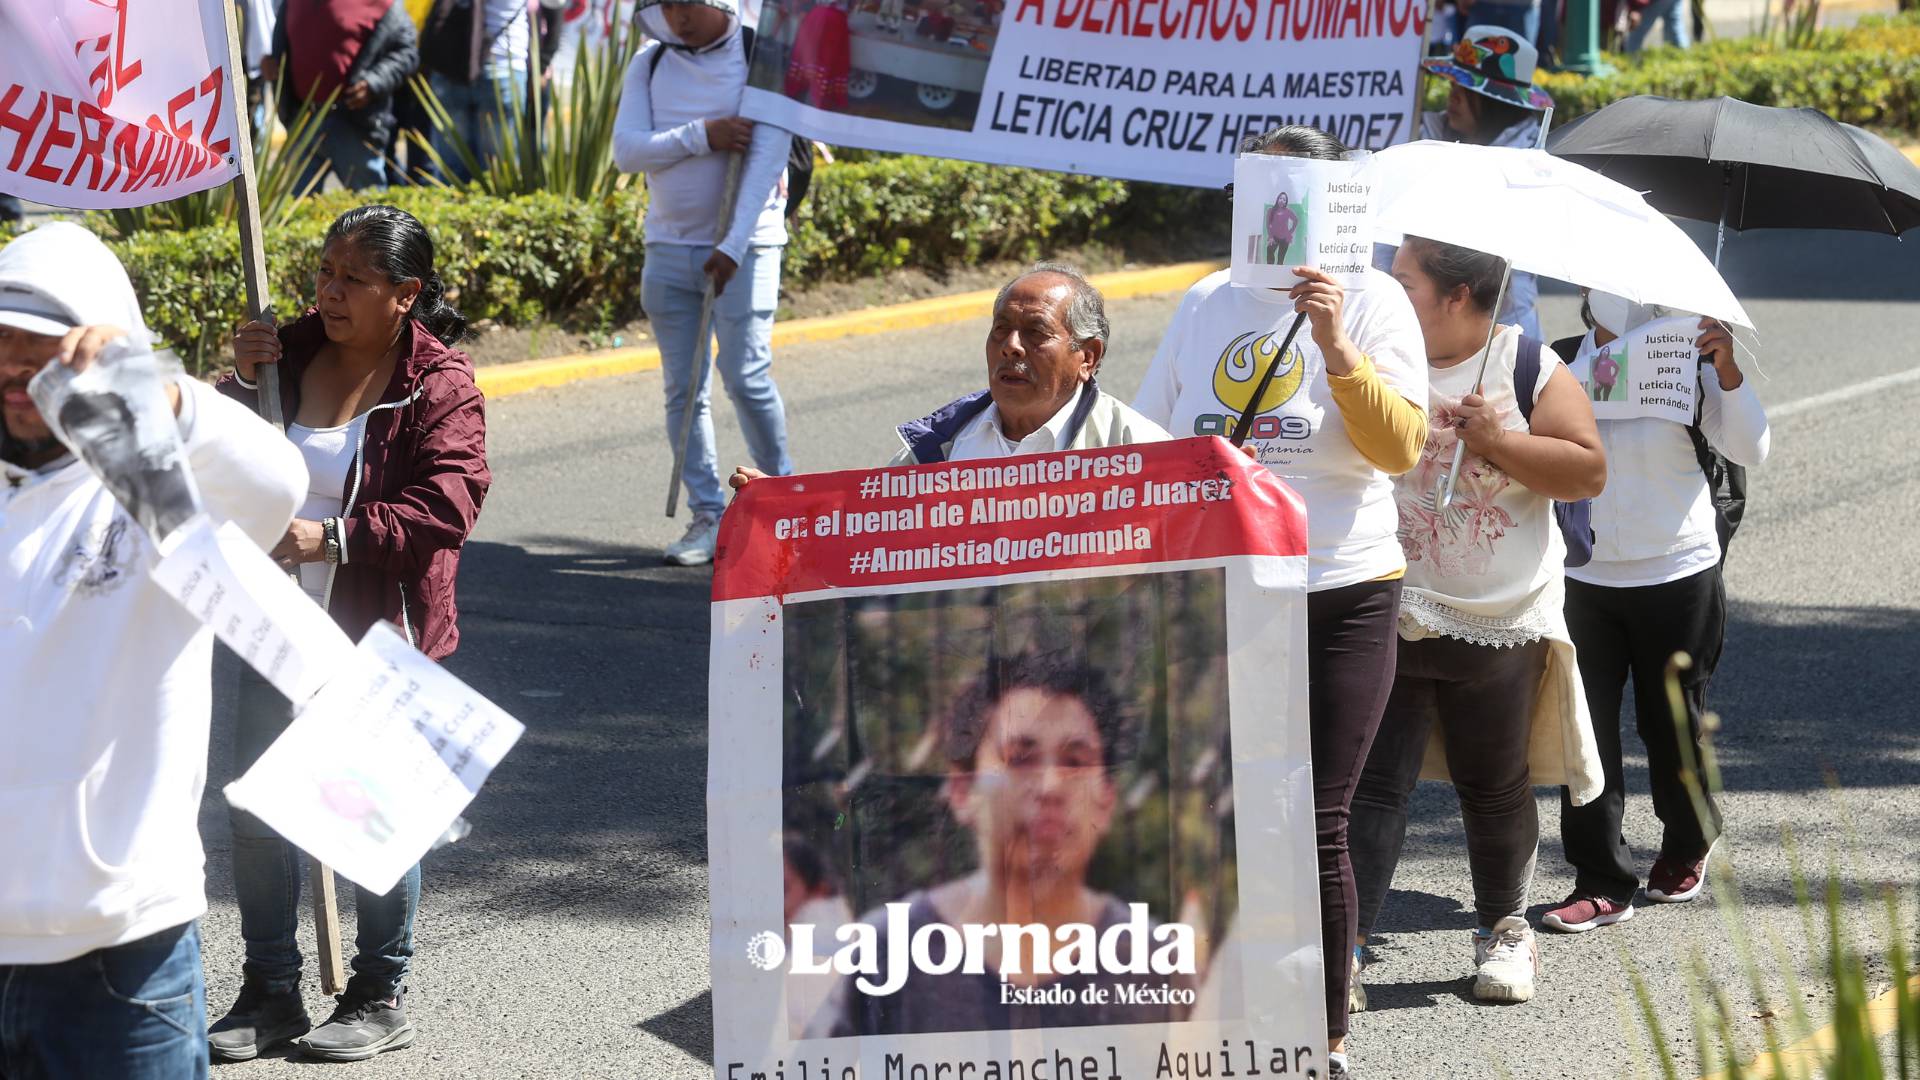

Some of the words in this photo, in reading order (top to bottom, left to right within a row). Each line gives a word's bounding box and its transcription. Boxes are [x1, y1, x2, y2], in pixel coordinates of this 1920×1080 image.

[1019, 55, 1156, 92] LIBERTAD
[1163, 70, 1235, 98] PARA
[1243, 73, 1275, 98] LA
[1283, 70, 1403, 98] MAESTRA
[990, 91, 1112, 143] LETICIA
[1122, 107, 1213, 152] CRUZ
[1216, 112, 1404, 154] HENDEZ
[1327, 182, 1363, 194] Justicia
[1365, 186, 1371, 196] y
[1328, 202, 1367, 214] Libertad
[1336, 225, 1357, 236] para
[1319, 242, 1348, 254] Leticia
[1350, 242, 1368, 254] Cruz
[1645, 333, 1685, 344] Justicia
[1687, 337, 1694, 346] y
[1648, 350, 1691, 360] Libertad
[1657, 366, 1682, 376] para
[1639, 380, 1673, 391] Leticia
[1675, 382, 1692, 395] Cruz
[1640, 396, 1689, 412] Hernández
[860, 452, 1143, 499] #InjustamentePreso
[815, 510, 840, 537] el
[846, 503, 924, 537] penal
[930, 501, 964, 528] de
[970, 492, 1096, 525] Almoloya
[1102, 485, 1136, 512] de
[850, 524, 1152, 575] #AmnistiaQueCumpla
[885, 1046, 1122, 1080] Morranchel
[1156, 1040, 1312, 1080] Aquilar
